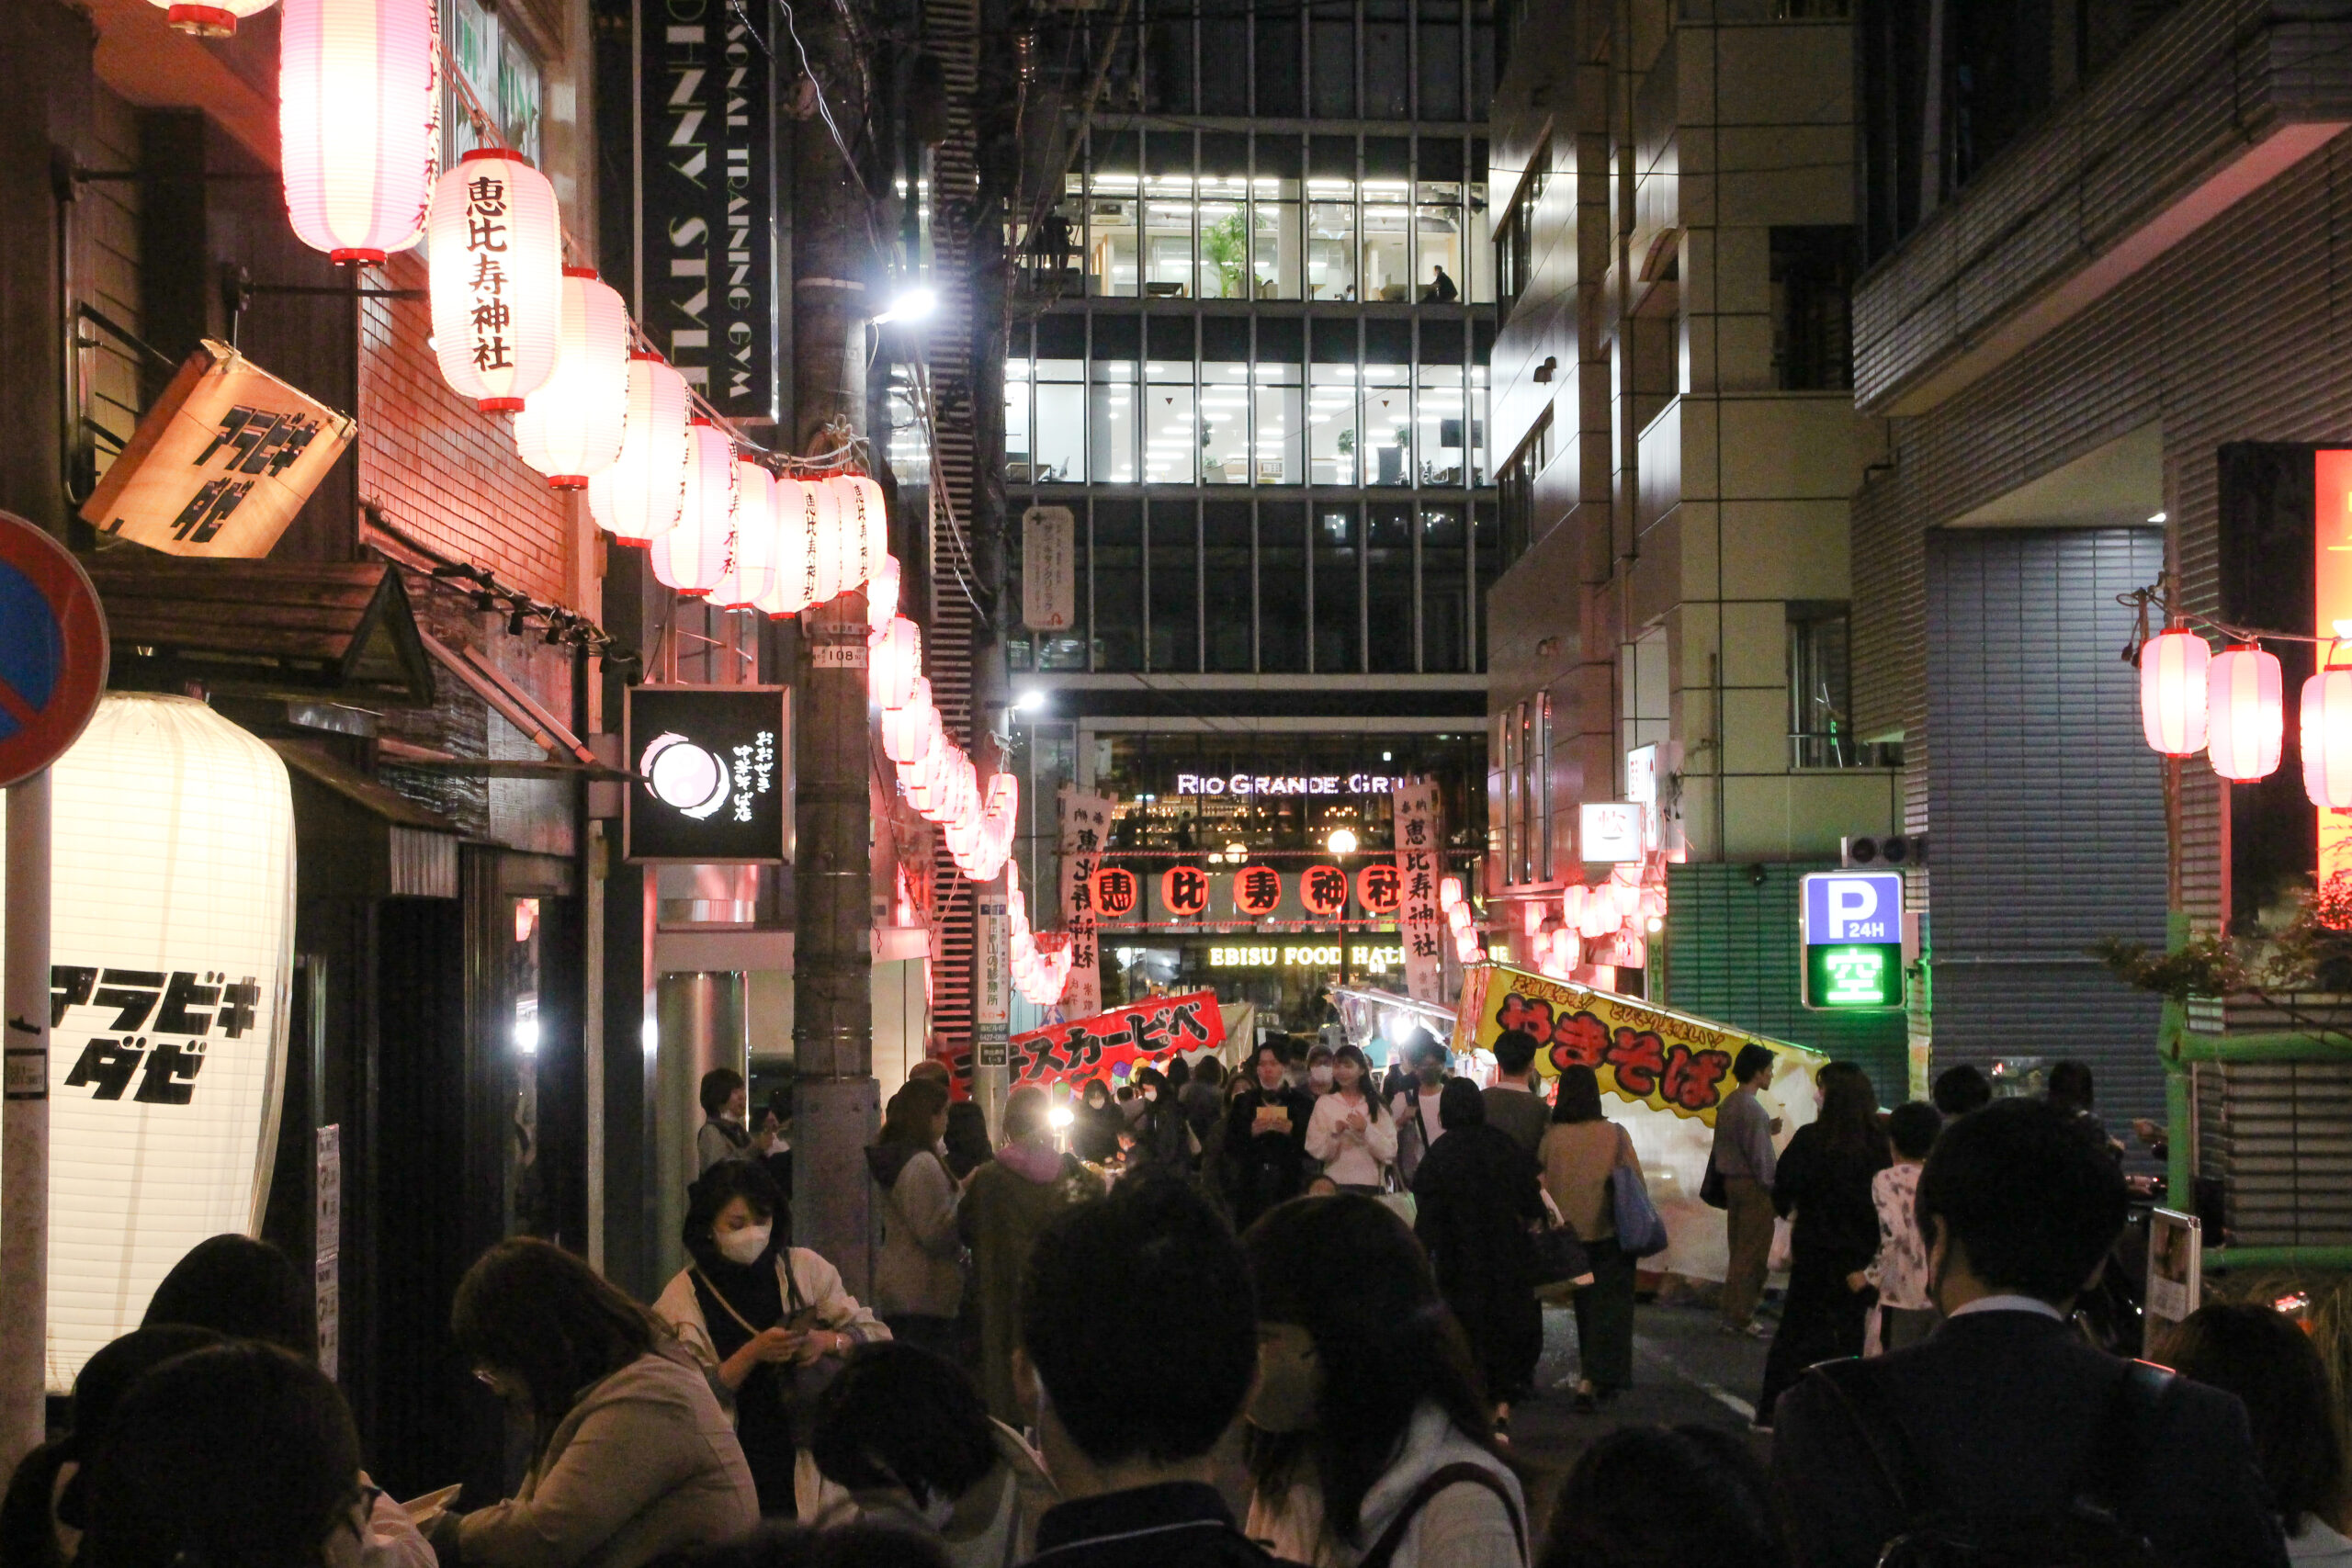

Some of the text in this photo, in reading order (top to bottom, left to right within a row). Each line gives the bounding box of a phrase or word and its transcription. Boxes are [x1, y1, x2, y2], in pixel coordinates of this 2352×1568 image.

[726, 143, 751, 310] TRAINING
[467, 175, 514, 373] 恵比寿神社
[669, 217, 709, 399] STYLE
[729, 321, 752, 398] GYM
[192, 404, 321, 477] アラビキ
[830, 650, 854, 660] 108
[1178, 774, 1225, 795] RIO
[1230, 773, 1339, 795] GRANDE
[1405, 818, 1438, 957] 恵比寿神社
[1828, 880, 1884, 939] P 24H
[1210, 946, 1277, 965] EBISU
[1283, 946, 1341, 965] FOOD
[1826, 948, 1883, 1000] 空
[1497, 993, 1733, 1111] やきそば
